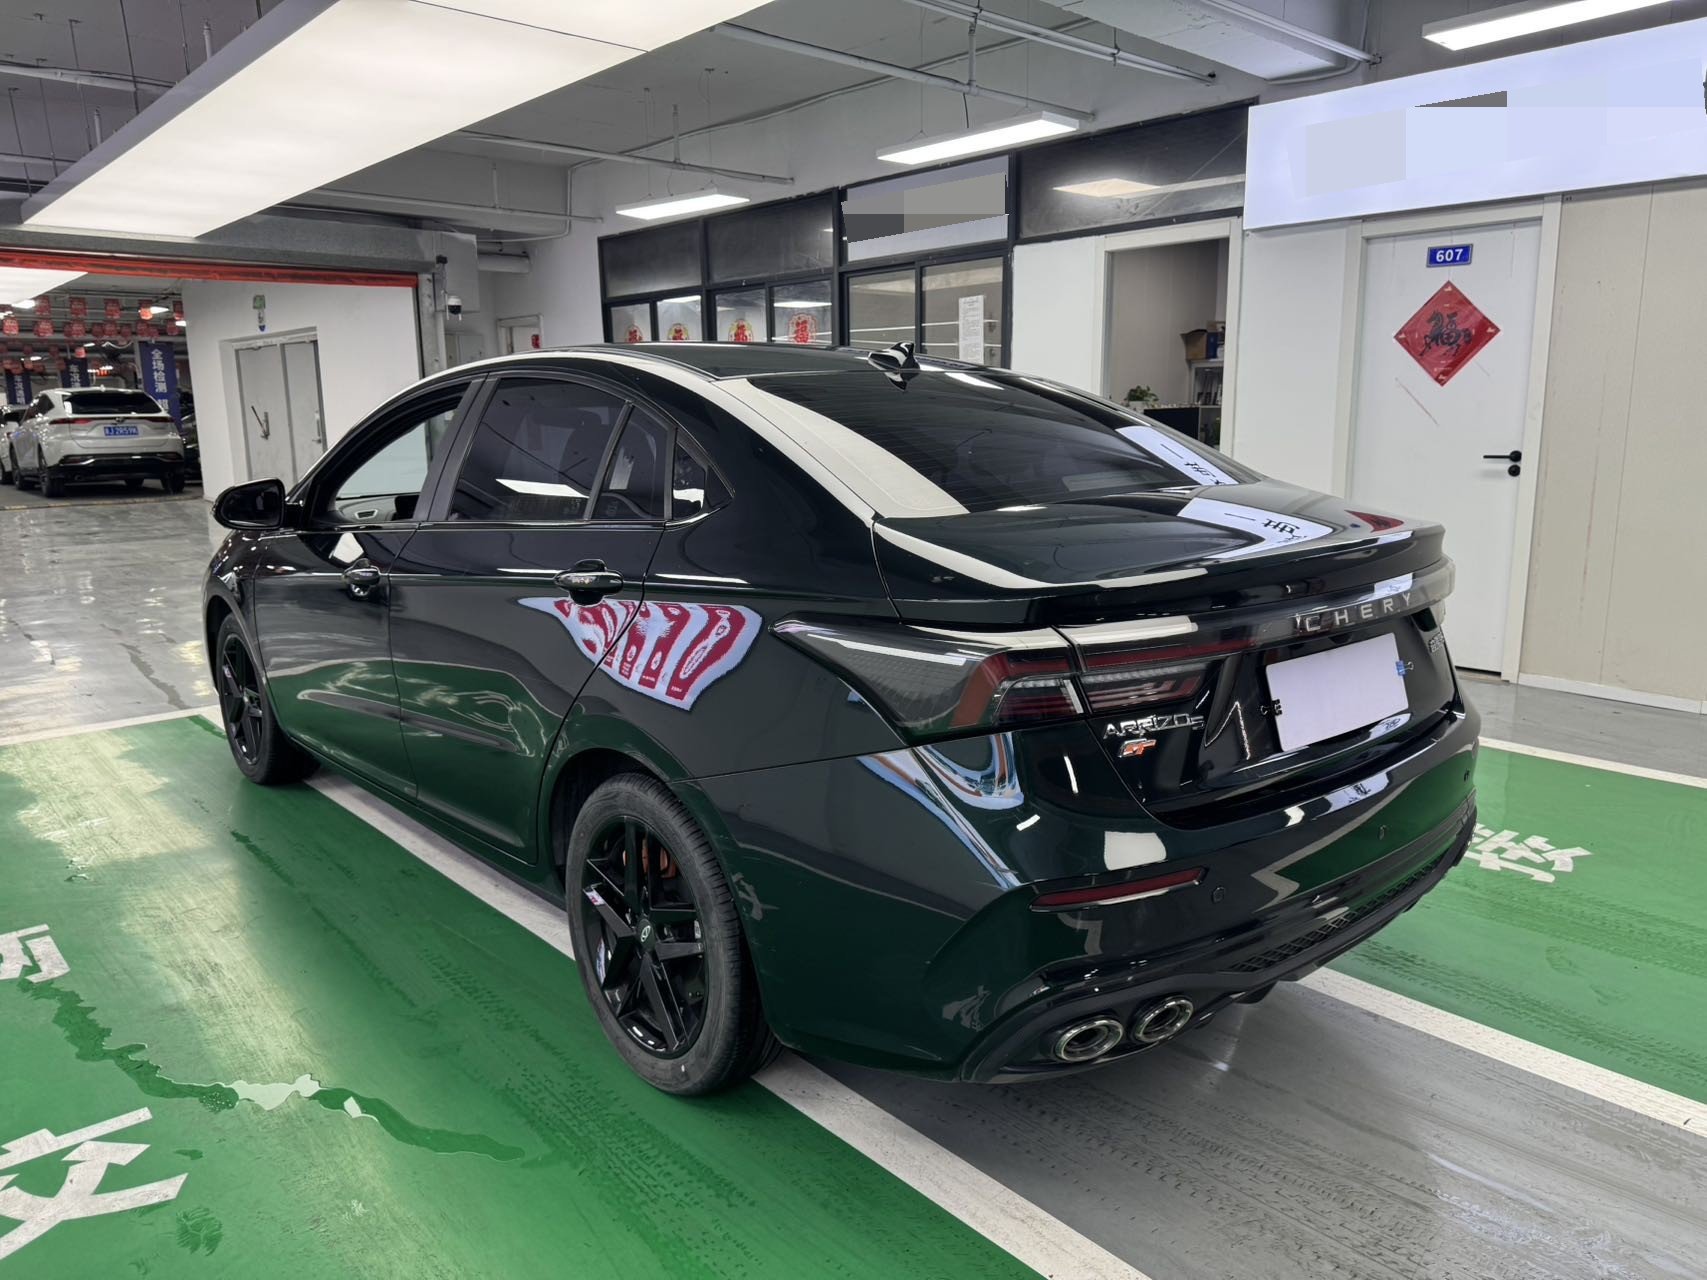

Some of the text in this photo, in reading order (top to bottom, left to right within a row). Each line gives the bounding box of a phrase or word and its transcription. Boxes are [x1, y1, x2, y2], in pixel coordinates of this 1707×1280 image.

[1435, 248, 1464, 263] 607
[151, 348, 168, 393] 全场检测
[1305, 592, 1412, 632] CHERY
